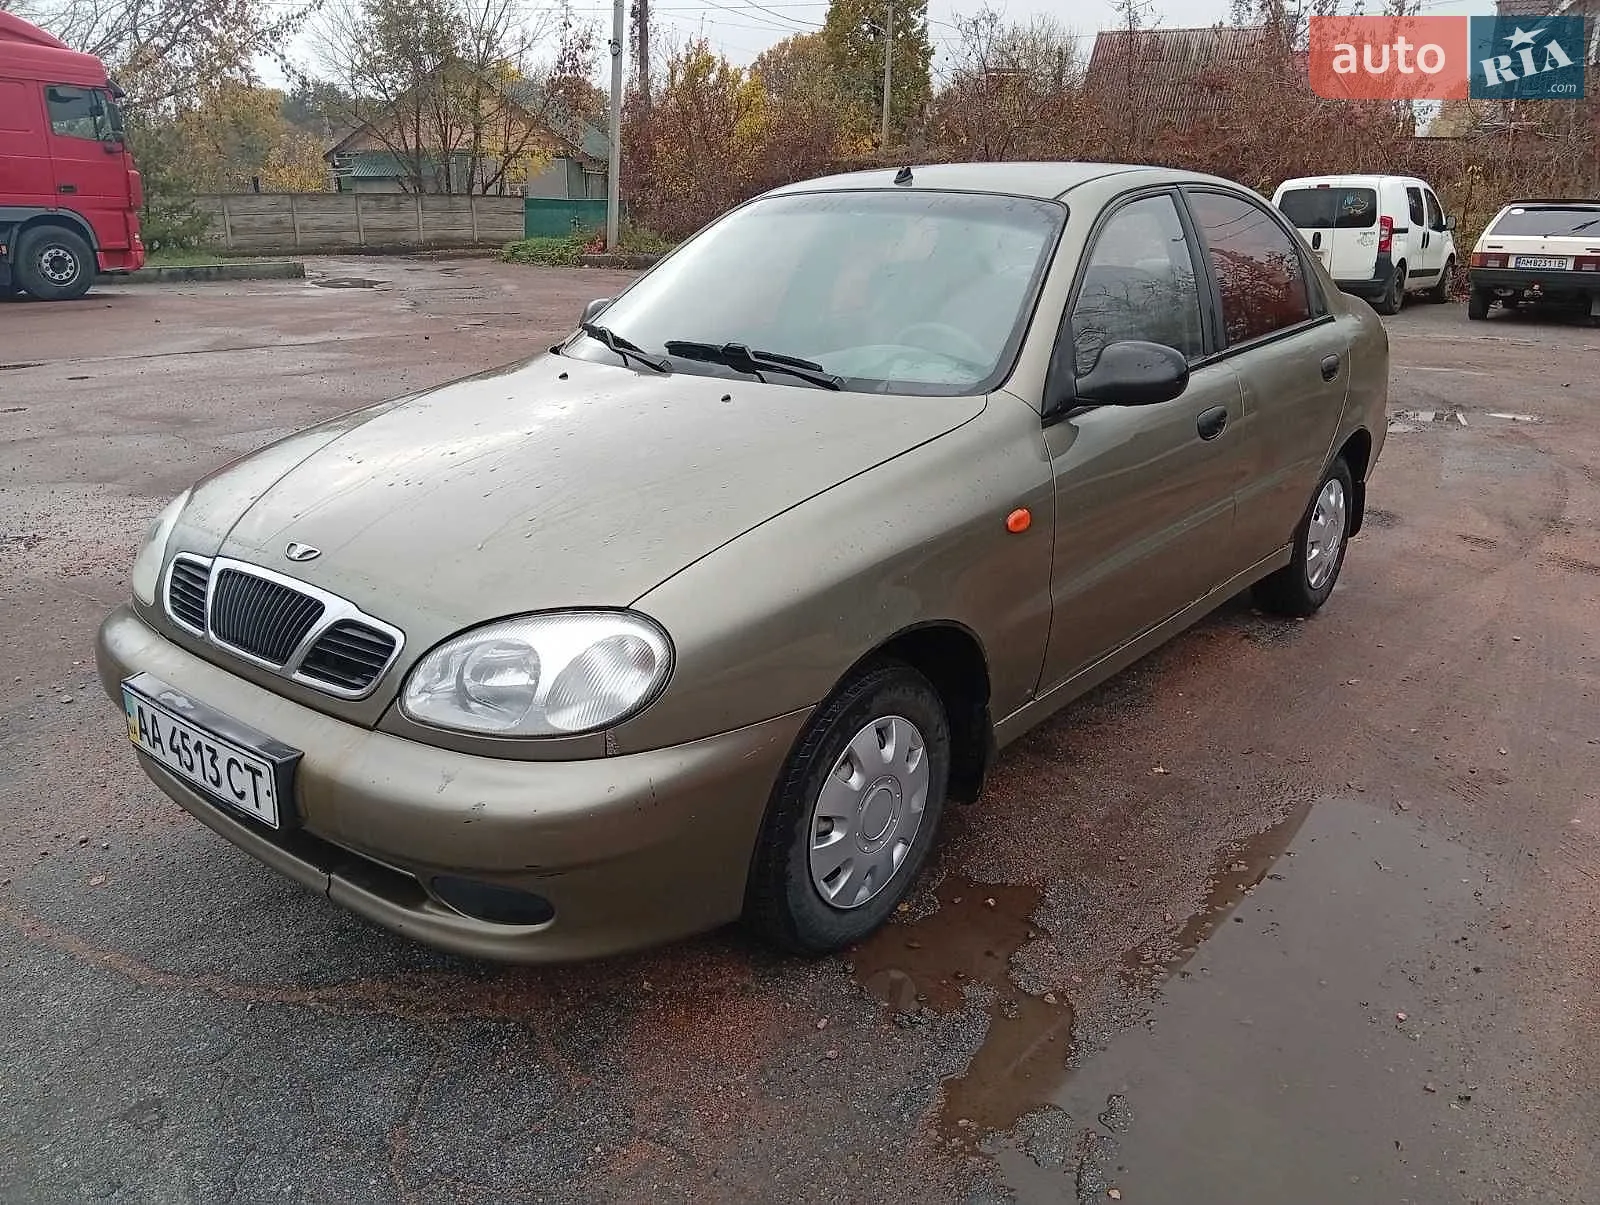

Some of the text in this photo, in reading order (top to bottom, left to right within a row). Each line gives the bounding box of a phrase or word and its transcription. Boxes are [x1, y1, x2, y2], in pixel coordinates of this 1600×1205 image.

[137, 704, 264, 809] AA 4513 CT
